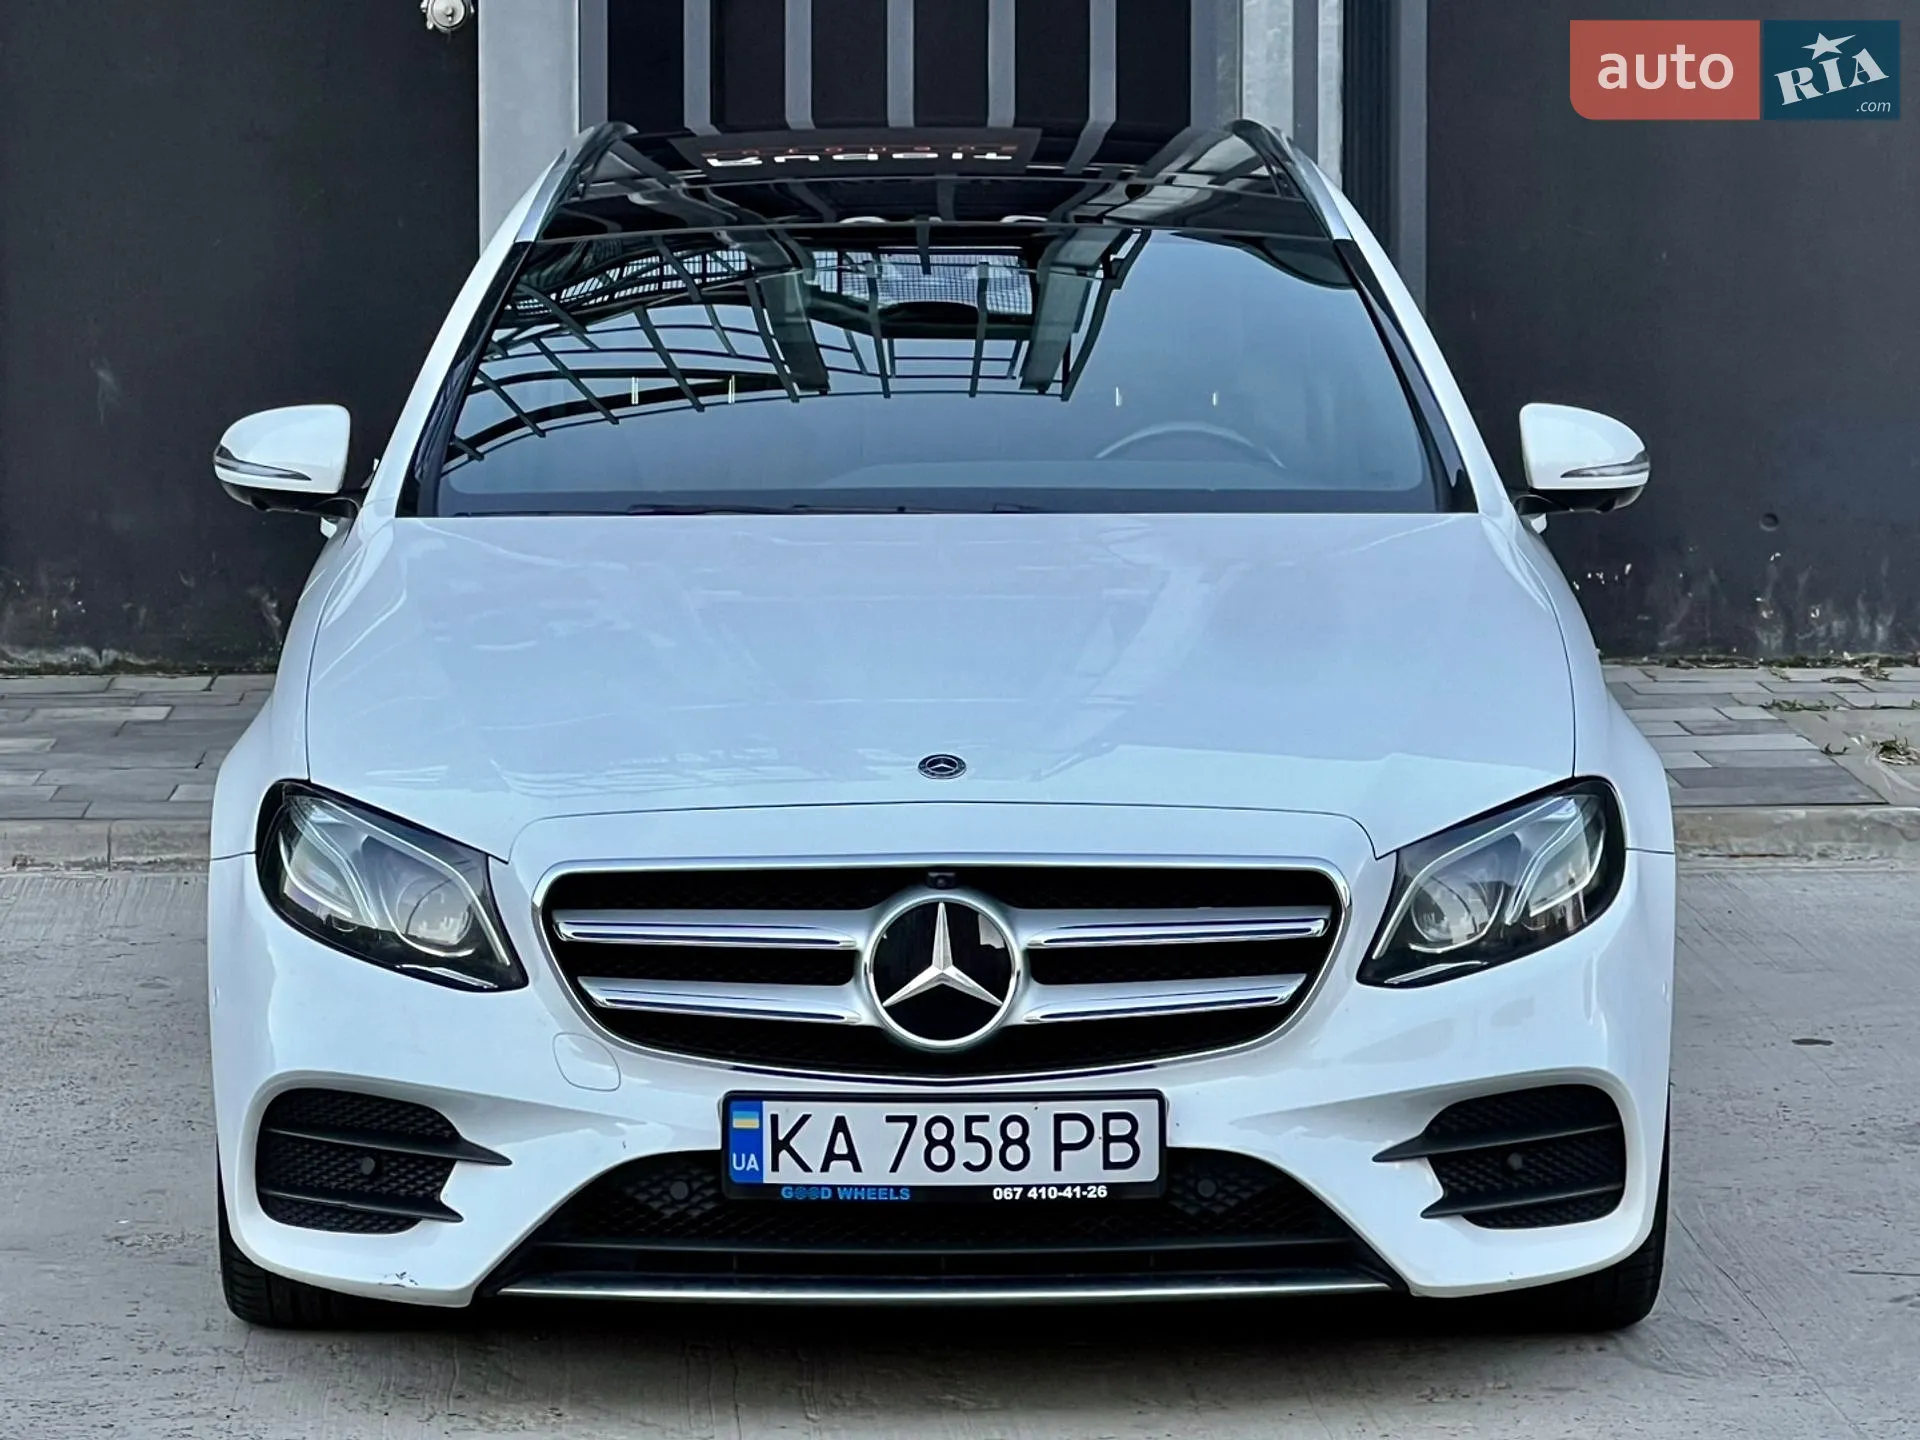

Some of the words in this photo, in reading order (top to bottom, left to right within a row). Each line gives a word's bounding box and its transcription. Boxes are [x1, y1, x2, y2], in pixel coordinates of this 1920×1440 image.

[769, 1113, 863, 1174] KA
[885, 1114, 1031, 1174] 7858
[1052, 1112, 1141, 1172] PB
[732, 1152, 760, 1172] UA
[781, 1186, 832, 1200] GOOD
[837, 1186, 911, 1200] WHEELS
[992, 1186, 1024, 1201] 067
[1027, 1185, 1108, 1201] 410-41-26
